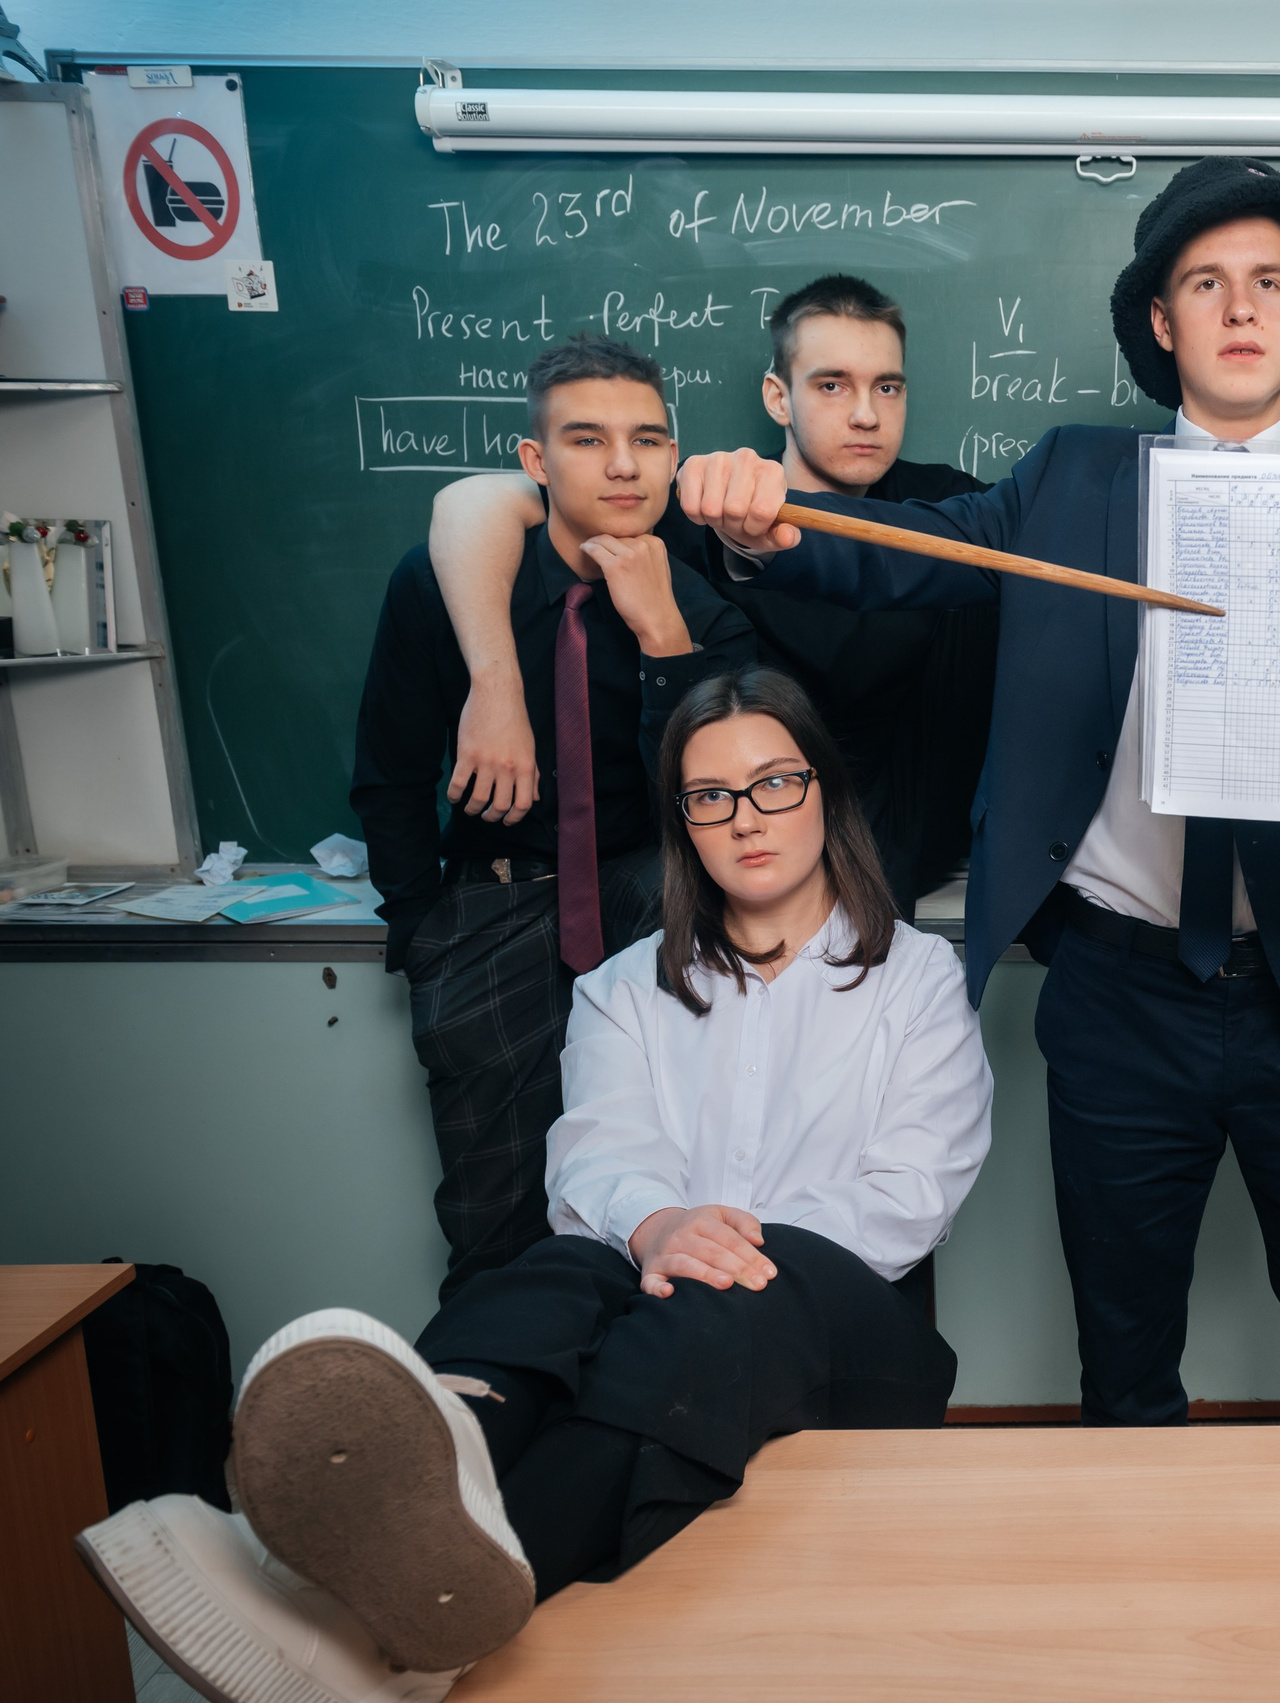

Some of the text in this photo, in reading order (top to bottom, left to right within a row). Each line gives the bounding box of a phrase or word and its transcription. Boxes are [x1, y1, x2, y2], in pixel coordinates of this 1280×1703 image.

[457, 112, 489, 121] Solution
[460, 103, 486, 112] Classic
[427, 199, 508, 255] The
[669, 189, 717, 243] of
[731, 186, 977, 234] November
[412, 285, 555, 342] Present
[603, 291, 733, 348] Perfect
[971, 341, 1068, 404] break
